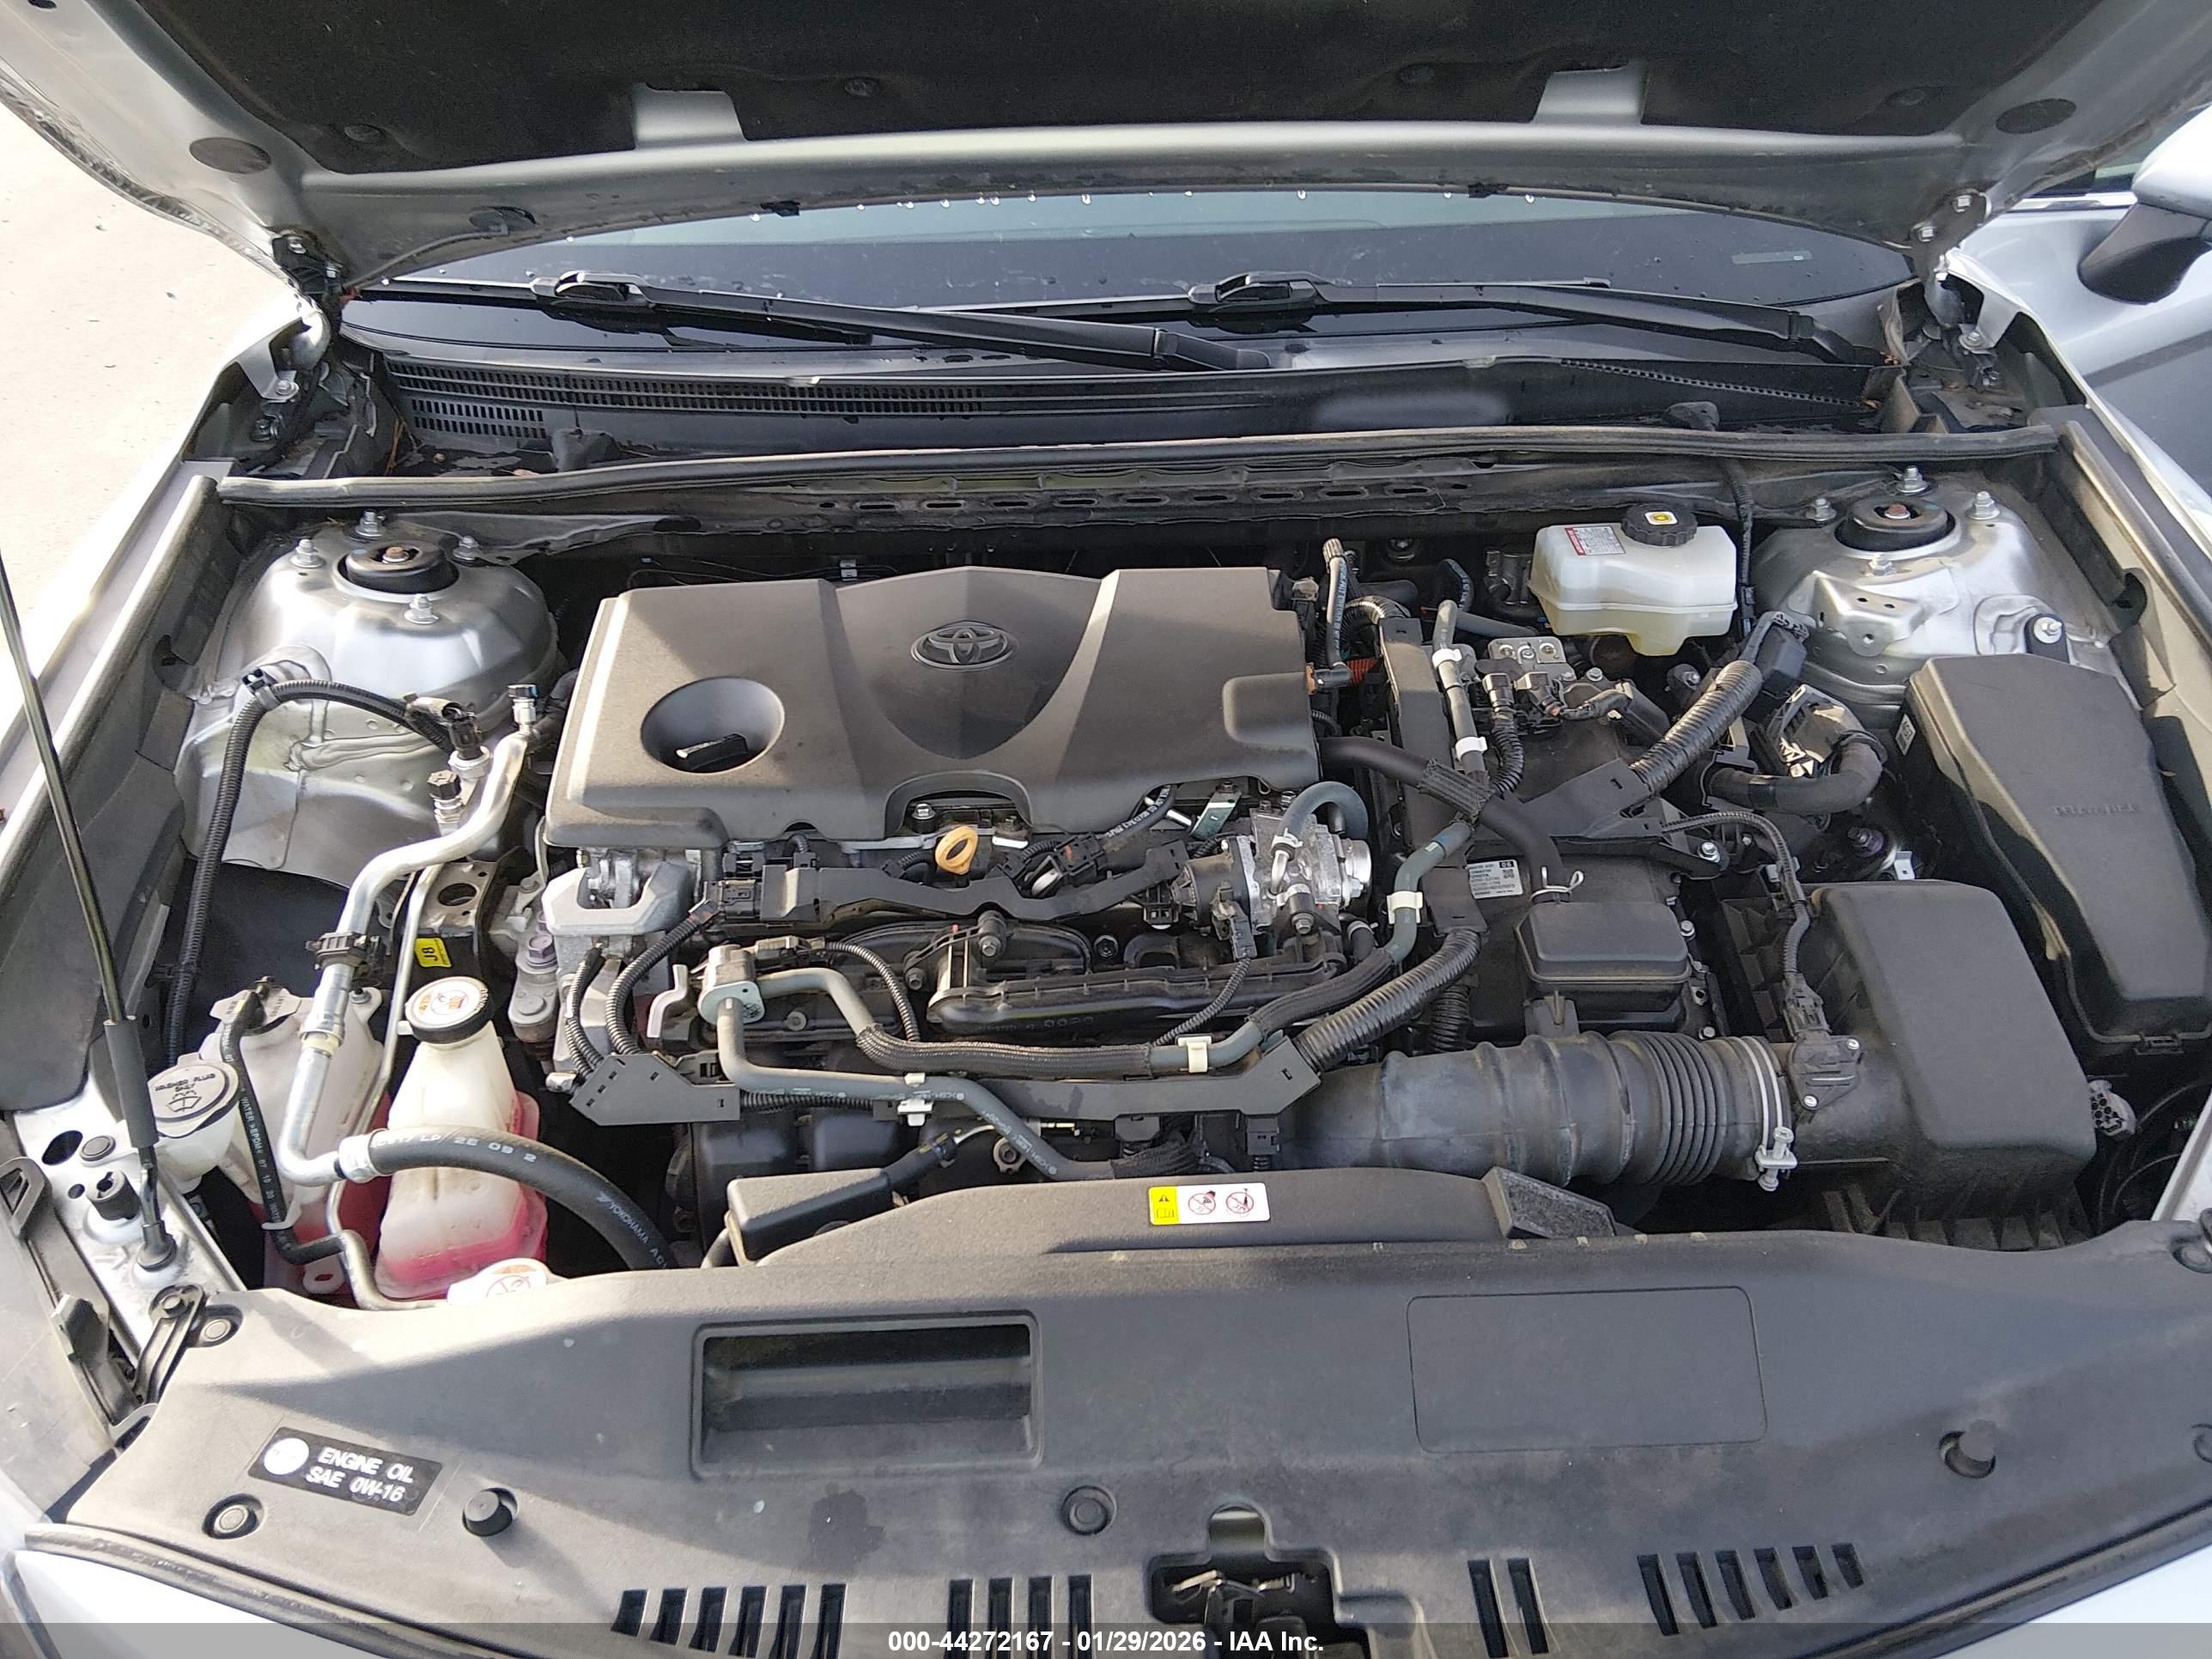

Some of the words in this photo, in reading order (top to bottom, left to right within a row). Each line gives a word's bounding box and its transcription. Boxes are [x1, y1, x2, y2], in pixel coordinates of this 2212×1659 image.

[240, 1097, 255, 1123] WATER
[610, 1202, 649, 1244] YOKOHAMA
[305, 1465, 345, 1488] SAE
[349, 1476, 406, 1502] 0W-16
[318, 1446, 383, 1475] ENGINE
[386, 1463, 414, 1484] OIL
